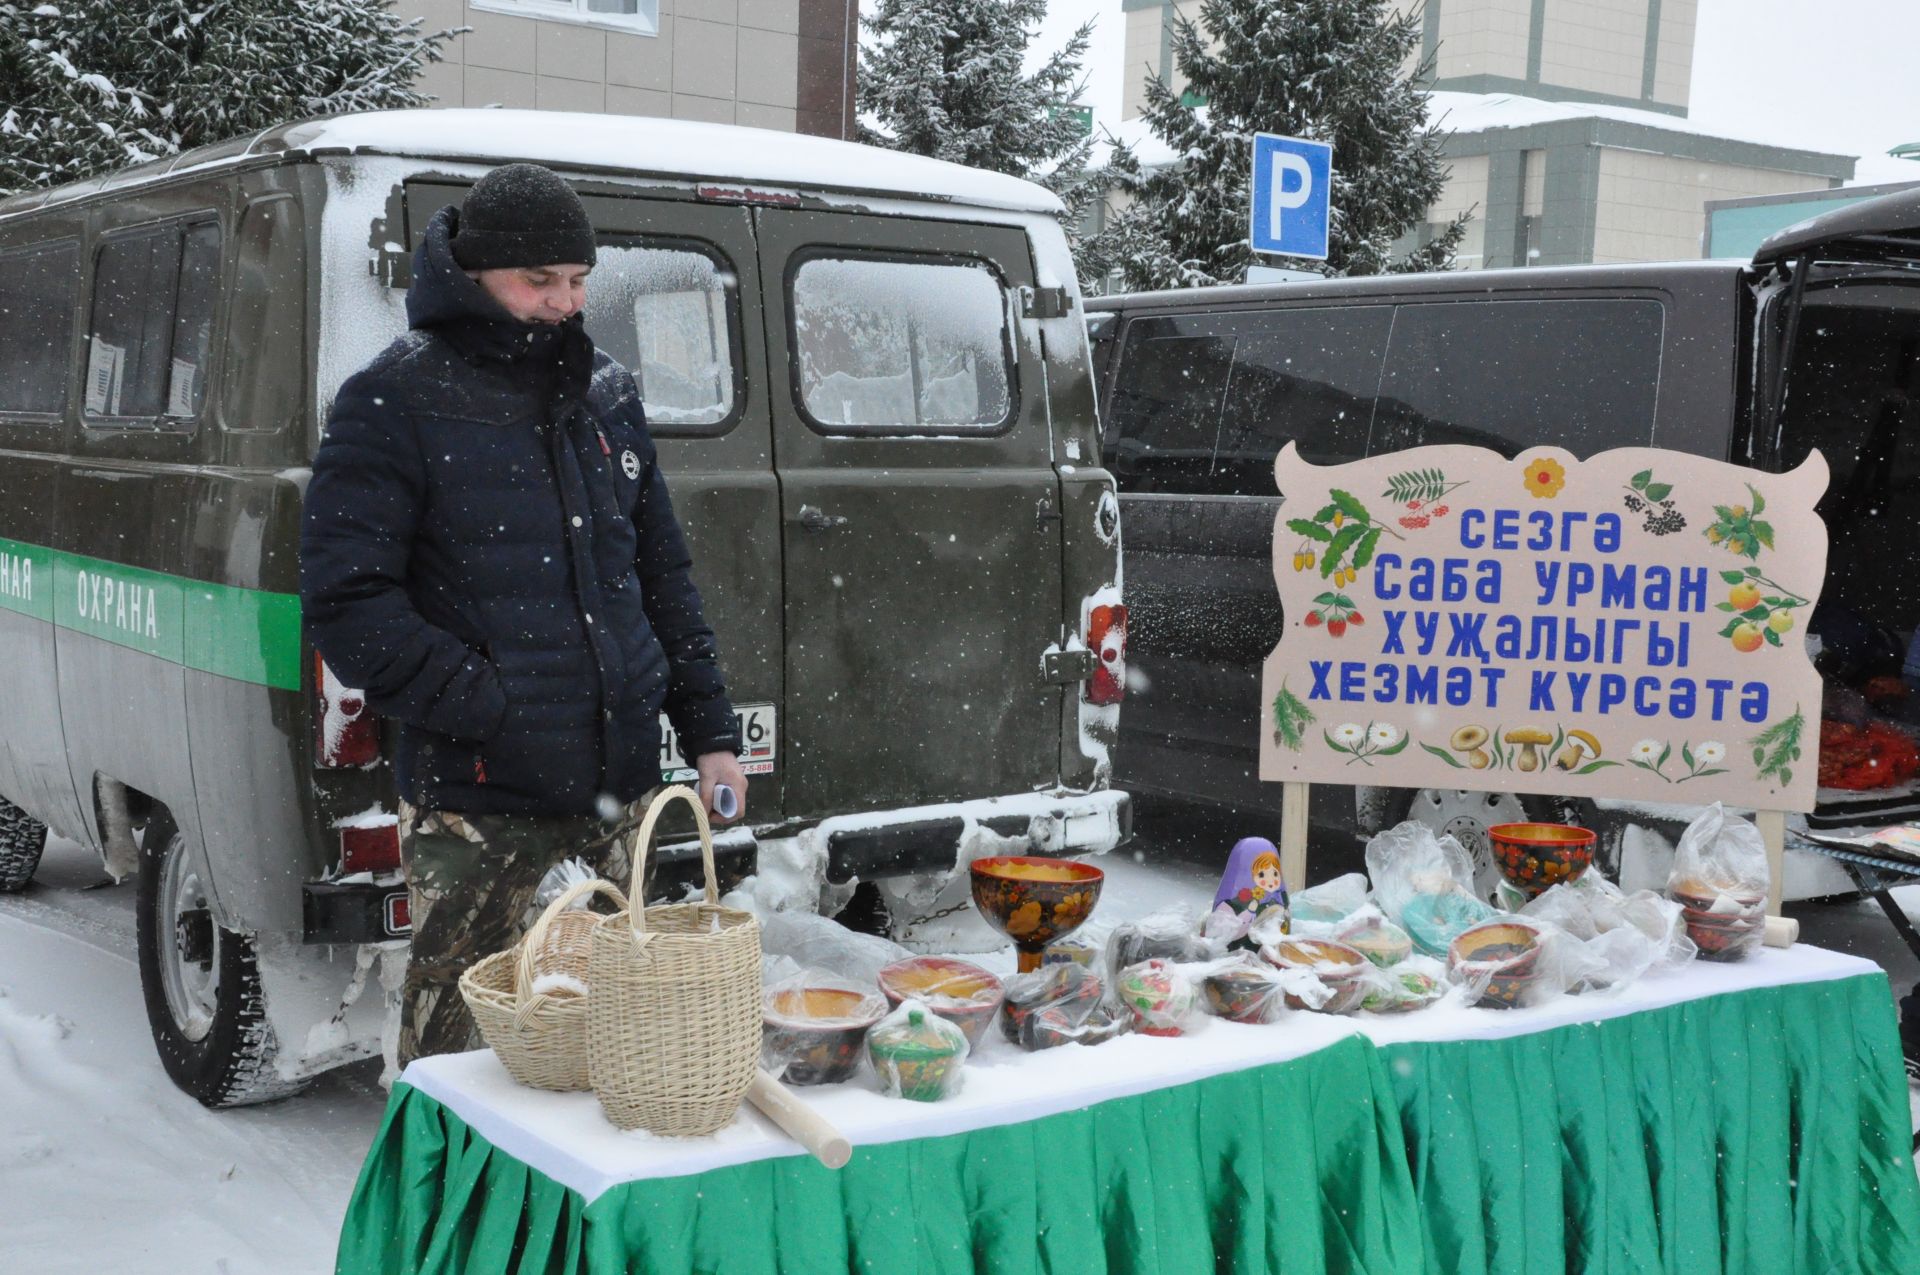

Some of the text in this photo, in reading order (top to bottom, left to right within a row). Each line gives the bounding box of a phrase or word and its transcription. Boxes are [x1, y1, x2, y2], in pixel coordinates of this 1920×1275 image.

[1270, 151, 1312, 241] P
[1461, 508, 1622, 553] СЕЗГӘ
[78, 569, 157, 639] ОХРАНА
[1309, 660, 1506, 709] ХЕЗМӘТ
